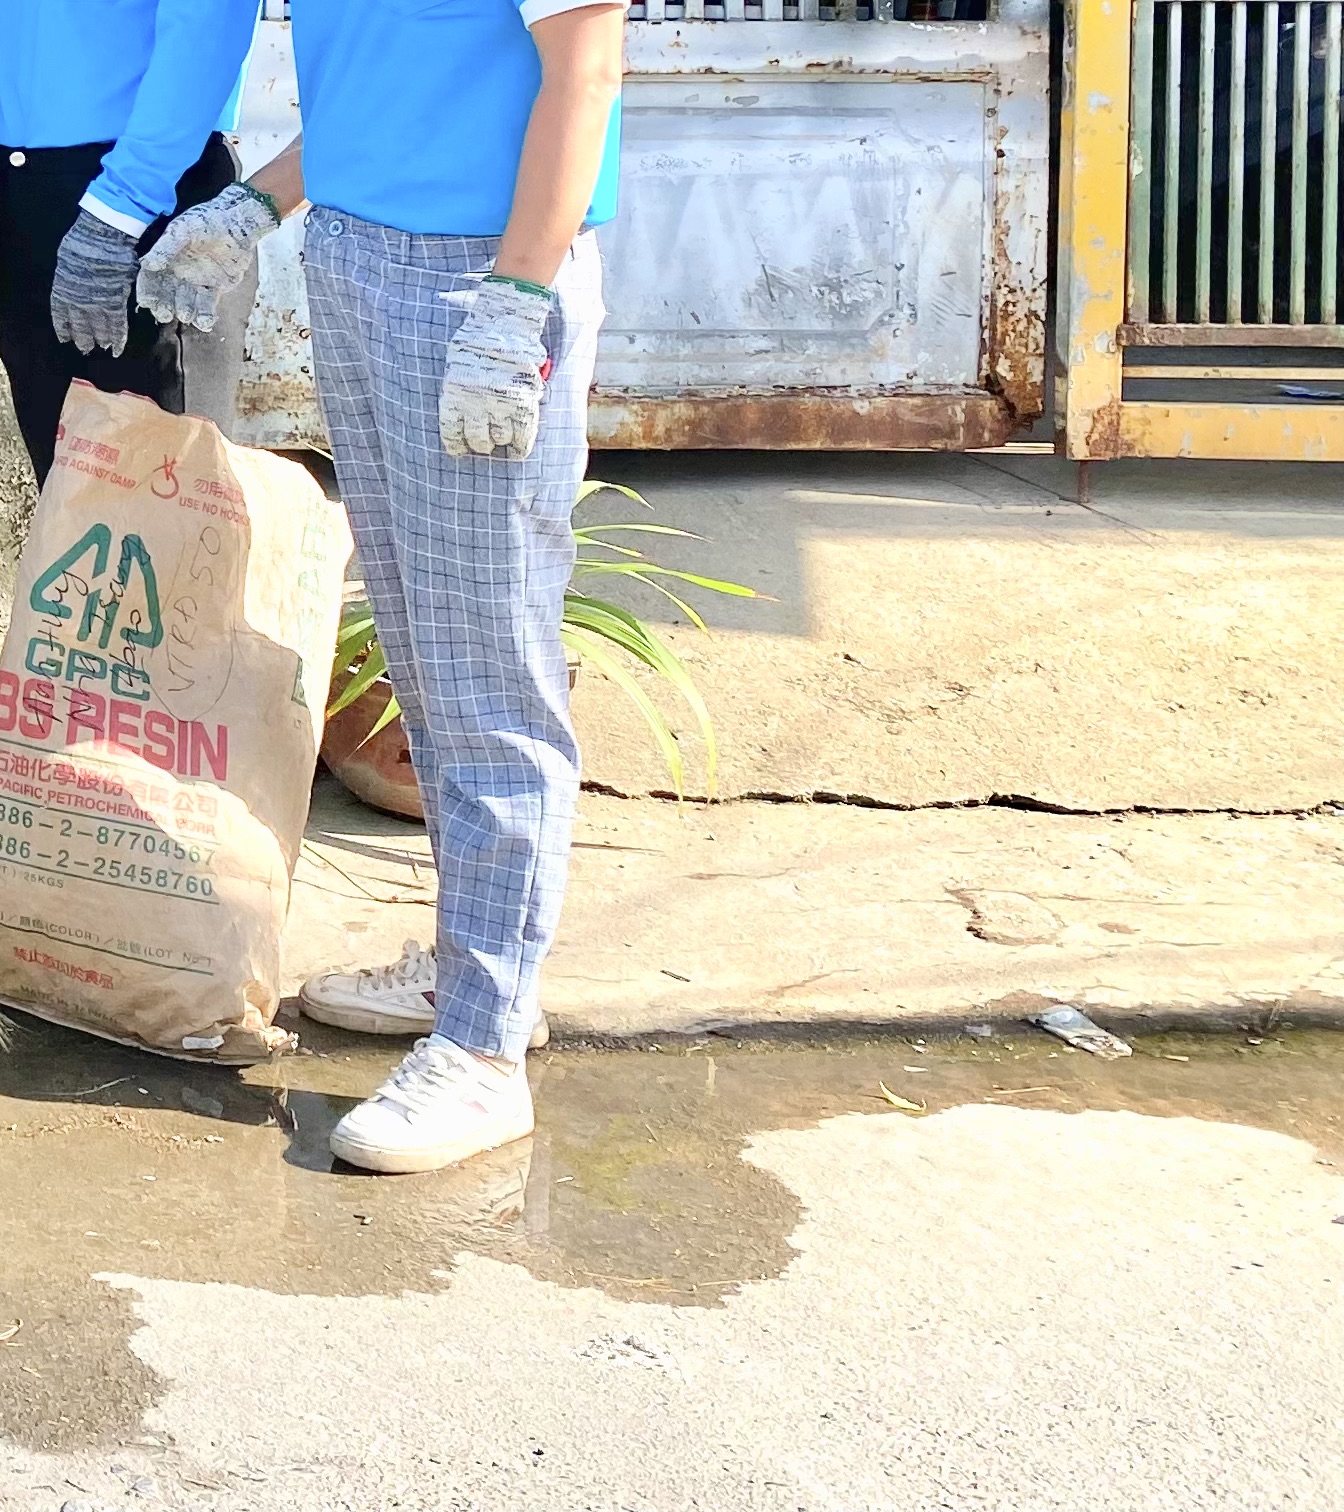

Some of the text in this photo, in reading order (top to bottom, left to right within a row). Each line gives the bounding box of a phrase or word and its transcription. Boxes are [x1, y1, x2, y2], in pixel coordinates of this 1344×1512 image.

[179, 496, 200, 511] USE
[202, 501, 219, 516] NO
[24, 637, 152, 701] GPC
[66, 687, 229, 782] RESIN
